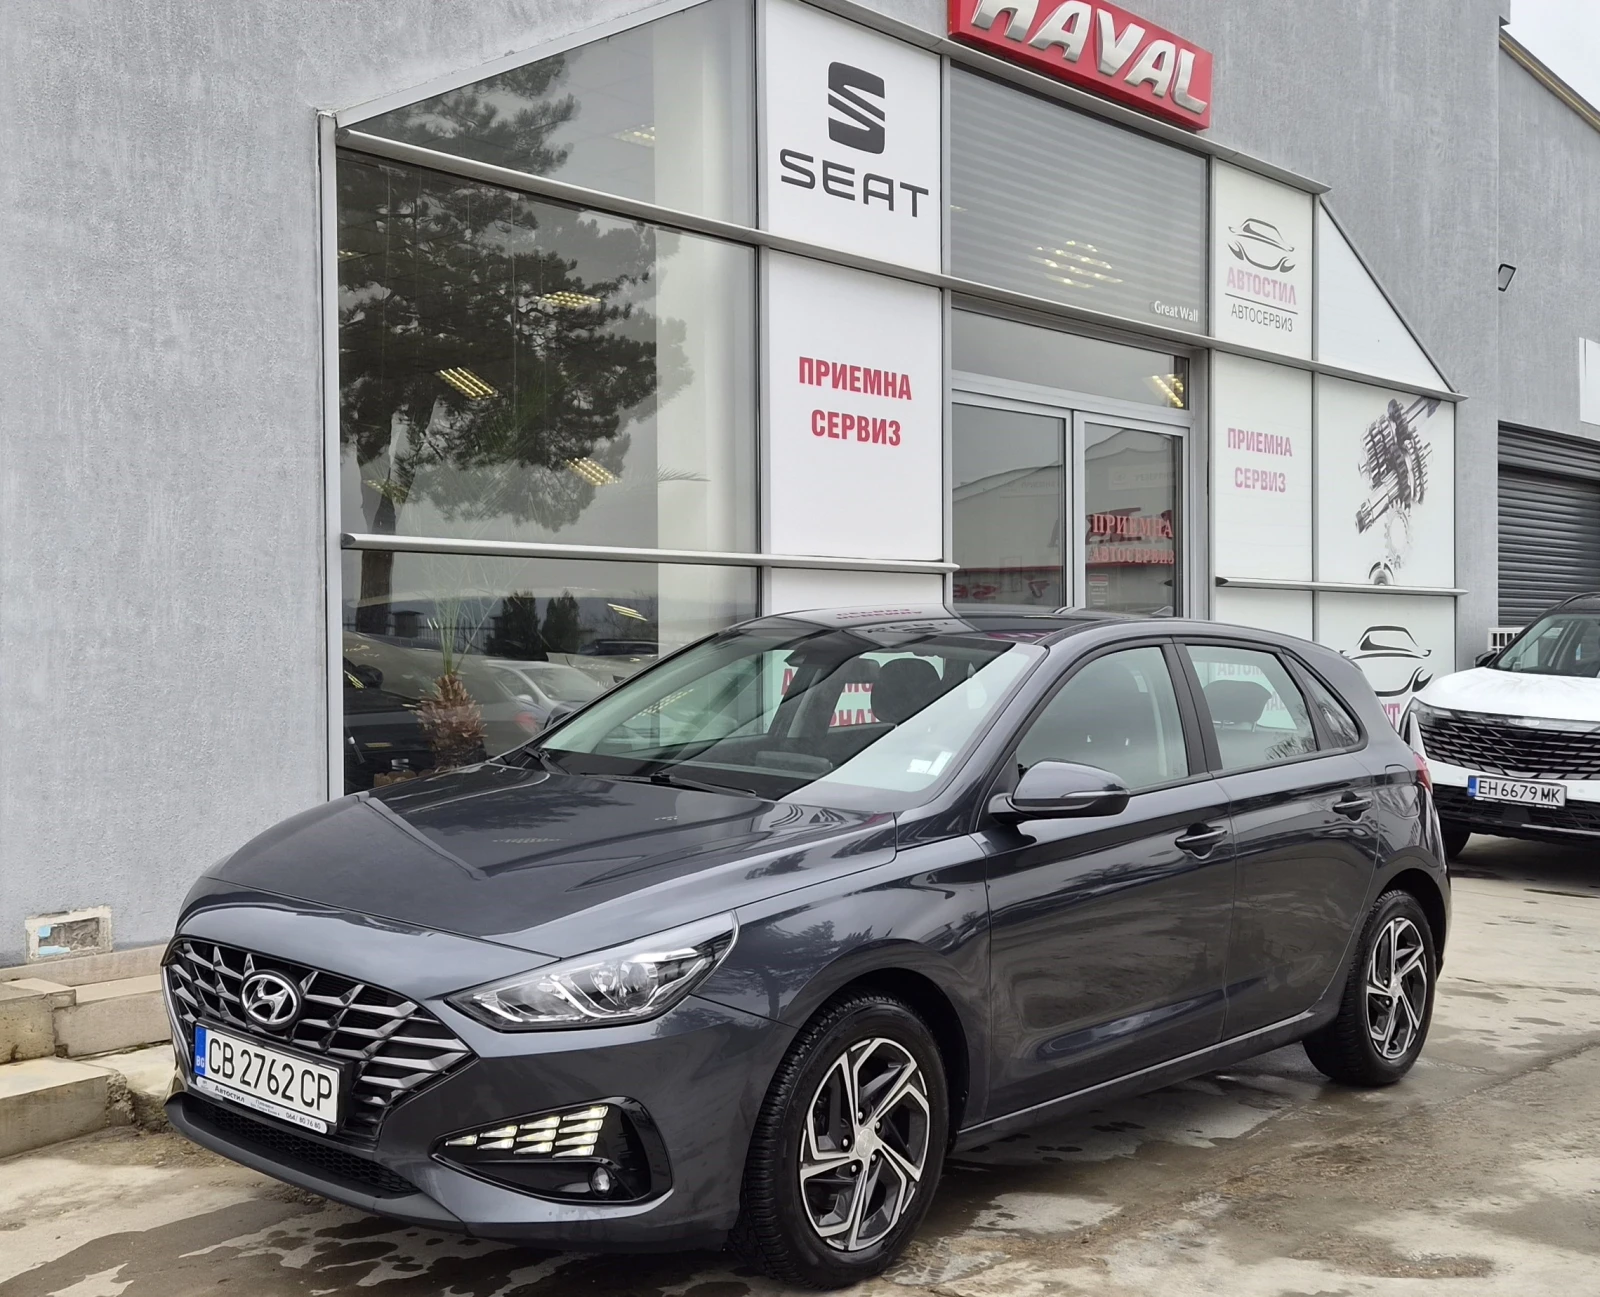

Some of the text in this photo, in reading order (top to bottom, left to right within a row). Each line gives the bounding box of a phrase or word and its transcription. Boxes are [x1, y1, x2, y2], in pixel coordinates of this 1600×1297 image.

[780, 148, 929, 218] SEAT
[1226, 266, 1297, 306] АВТОСТИЛ
[1154, 300, 1199, 323] Great Wall
[1230, 303, 1293, 333] АВТОСЕРВИЗ
[799, 356, 912, 401] ПРИЕМНА
[811, 409, 901, 447] СЕРВИЗ
[1227, 427, 1293, 457] ПРИЕМНА
[1234, 467, 1286, 493] СЕРВИЗ
[1092, 513, 1174, 538] ПРИЕМНА
[1091, 546, 1175, 565] АВТОСЕРВИЗ
[1478, 780, 1498, 796] EH
[1500, 783, 1538, 801] 6679
[1541, 787, 1561, 804] MK
[195, 1055, 205, 1068] BG
[208, 1038, 332, 1111] CB 2762 CP
